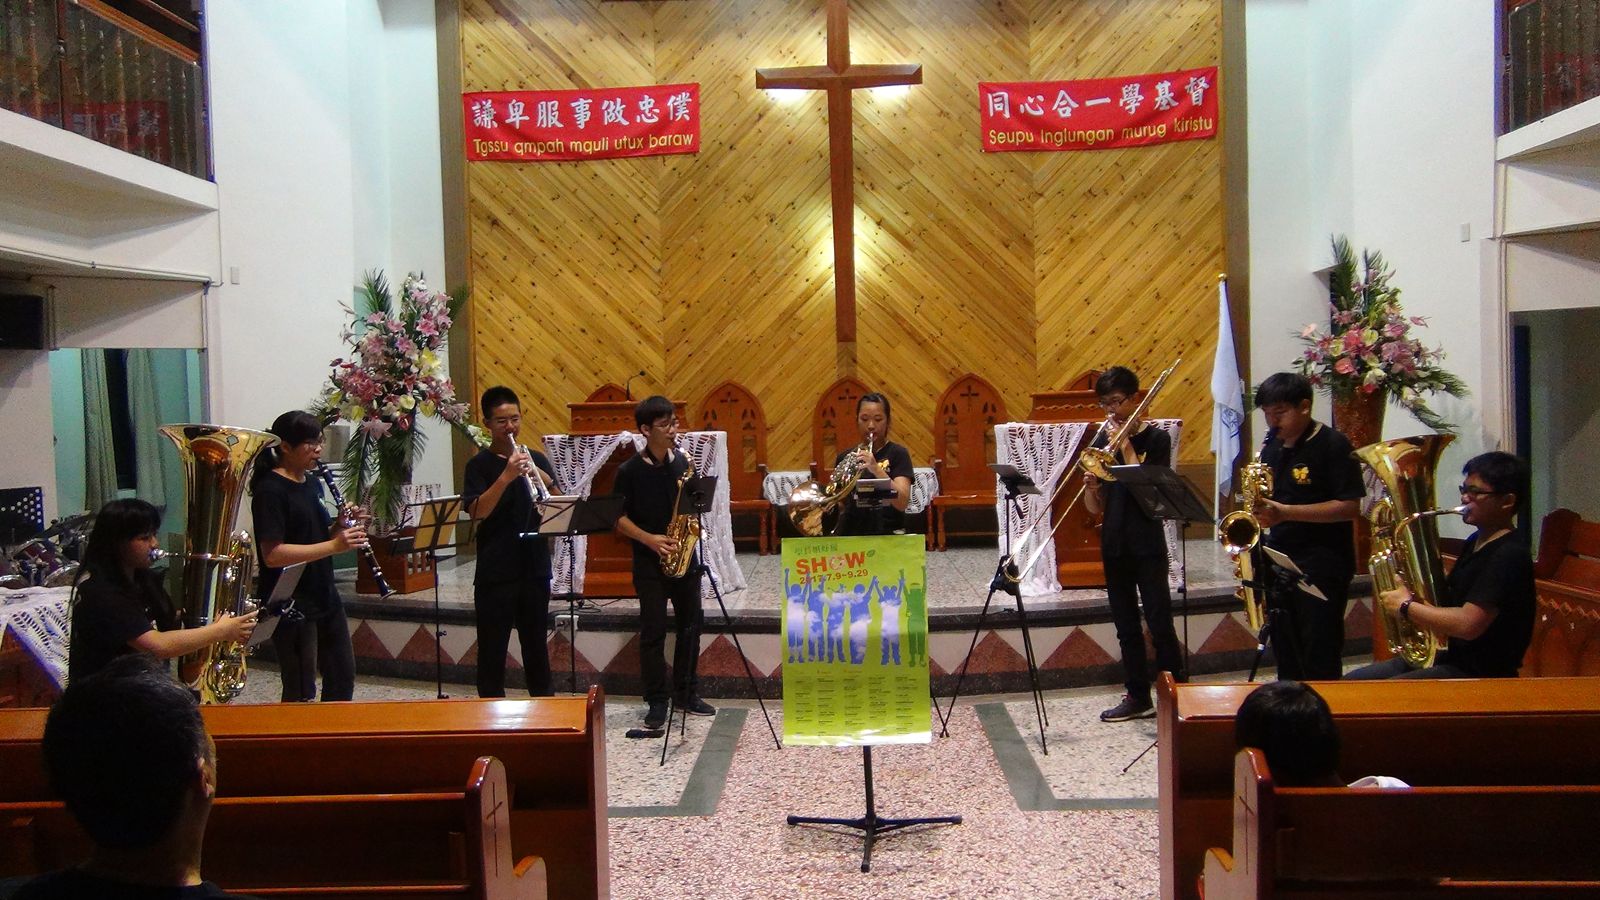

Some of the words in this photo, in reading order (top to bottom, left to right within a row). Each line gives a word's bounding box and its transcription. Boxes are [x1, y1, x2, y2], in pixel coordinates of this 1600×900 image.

[471, 91, 692, 130] 謙卑服事做忠僕
[987, 75, 1210, 119] 同心合一學基督
[473, 138, 508, 157] Tgssu
[514, 138, 564, 156] qmpah
[570, 137, 609, 155] mquli
[614, 135, 644, 150] utux
[649, 133, 694, 149] baraw
[989, 129, 1034, 146] Seupu
[1122, 123, 1166, 139] murug
[1174, 116, 1213, 133] kiristu
[796, 551, 866, 575] SHOW
